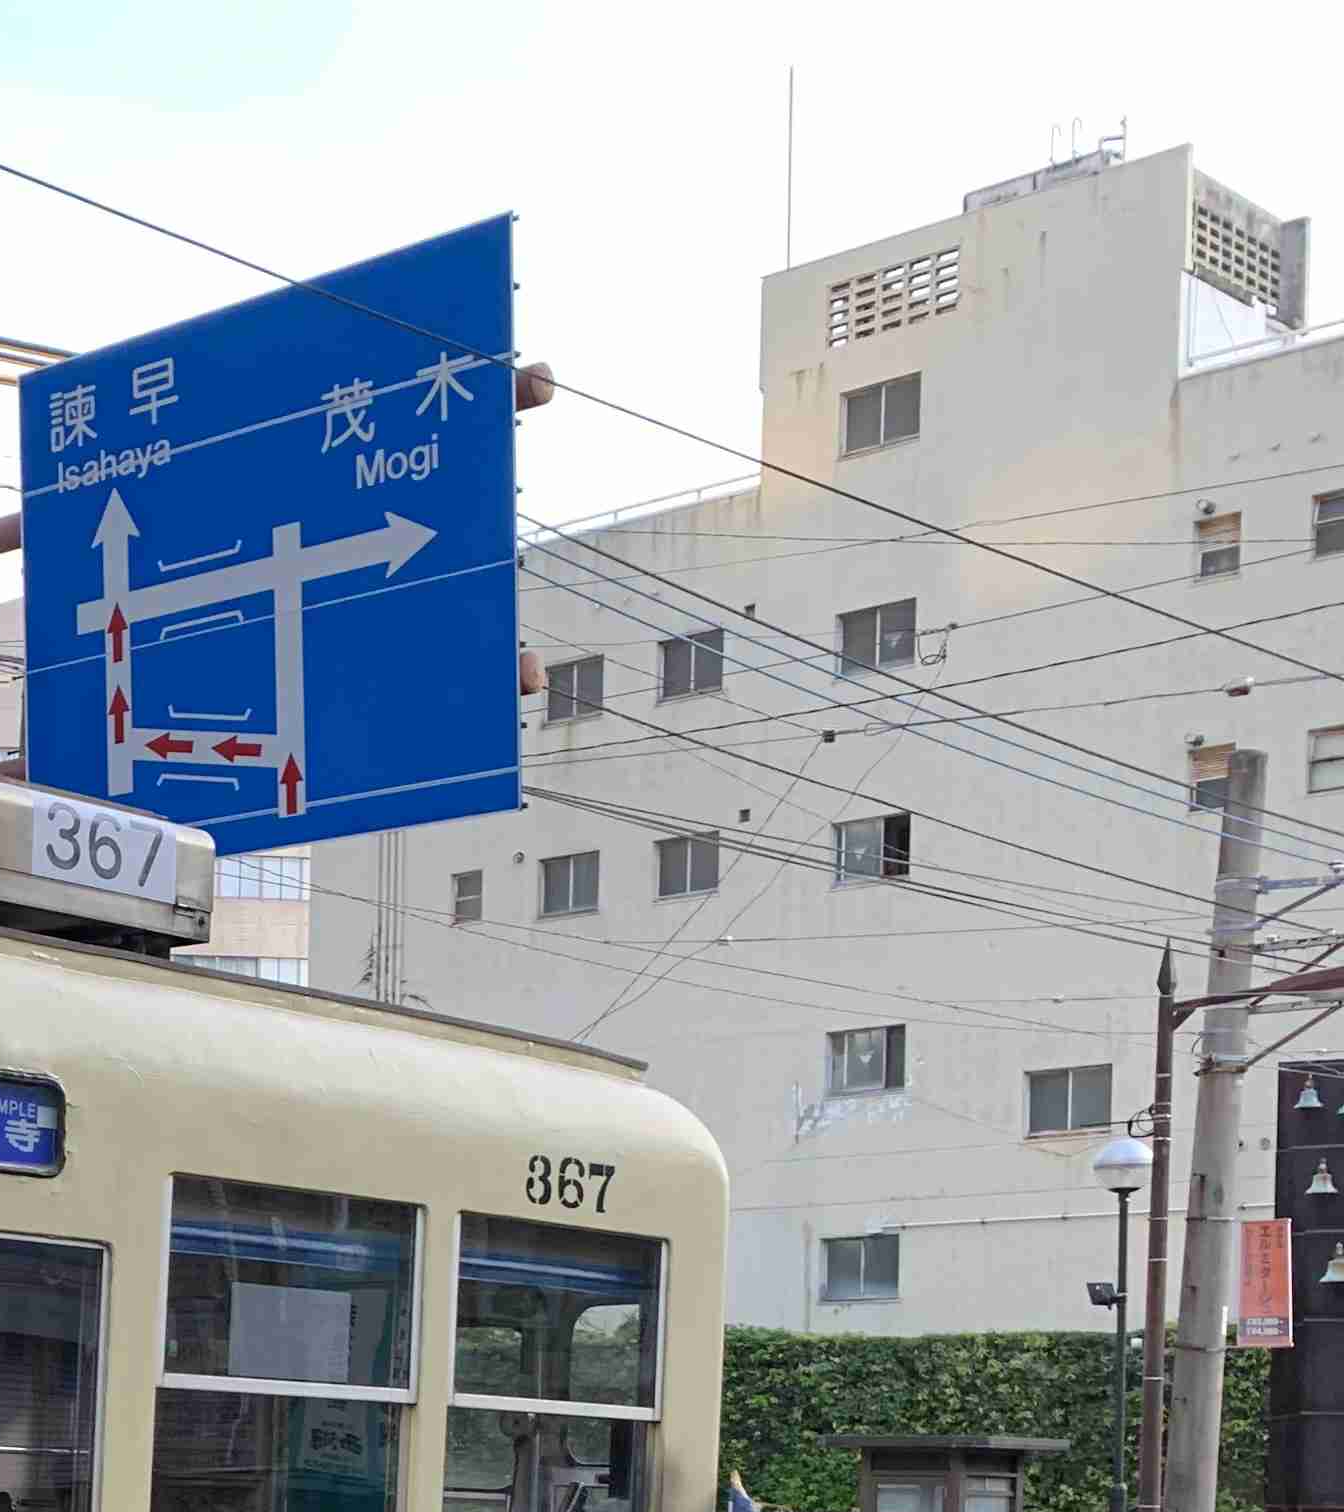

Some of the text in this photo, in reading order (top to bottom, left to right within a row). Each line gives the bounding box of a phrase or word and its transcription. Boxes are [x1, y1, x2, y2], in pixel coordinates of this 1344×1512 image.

[49, 356, 179, 453] 諫早
[321, 351, 474, 454] 茂木
[57, 439, 171, 494] Isahaya
[356, 434, 440, 489] Mogi
[45, 801, 163, 888] 367
[525, 1154, 616, 1214] 367
